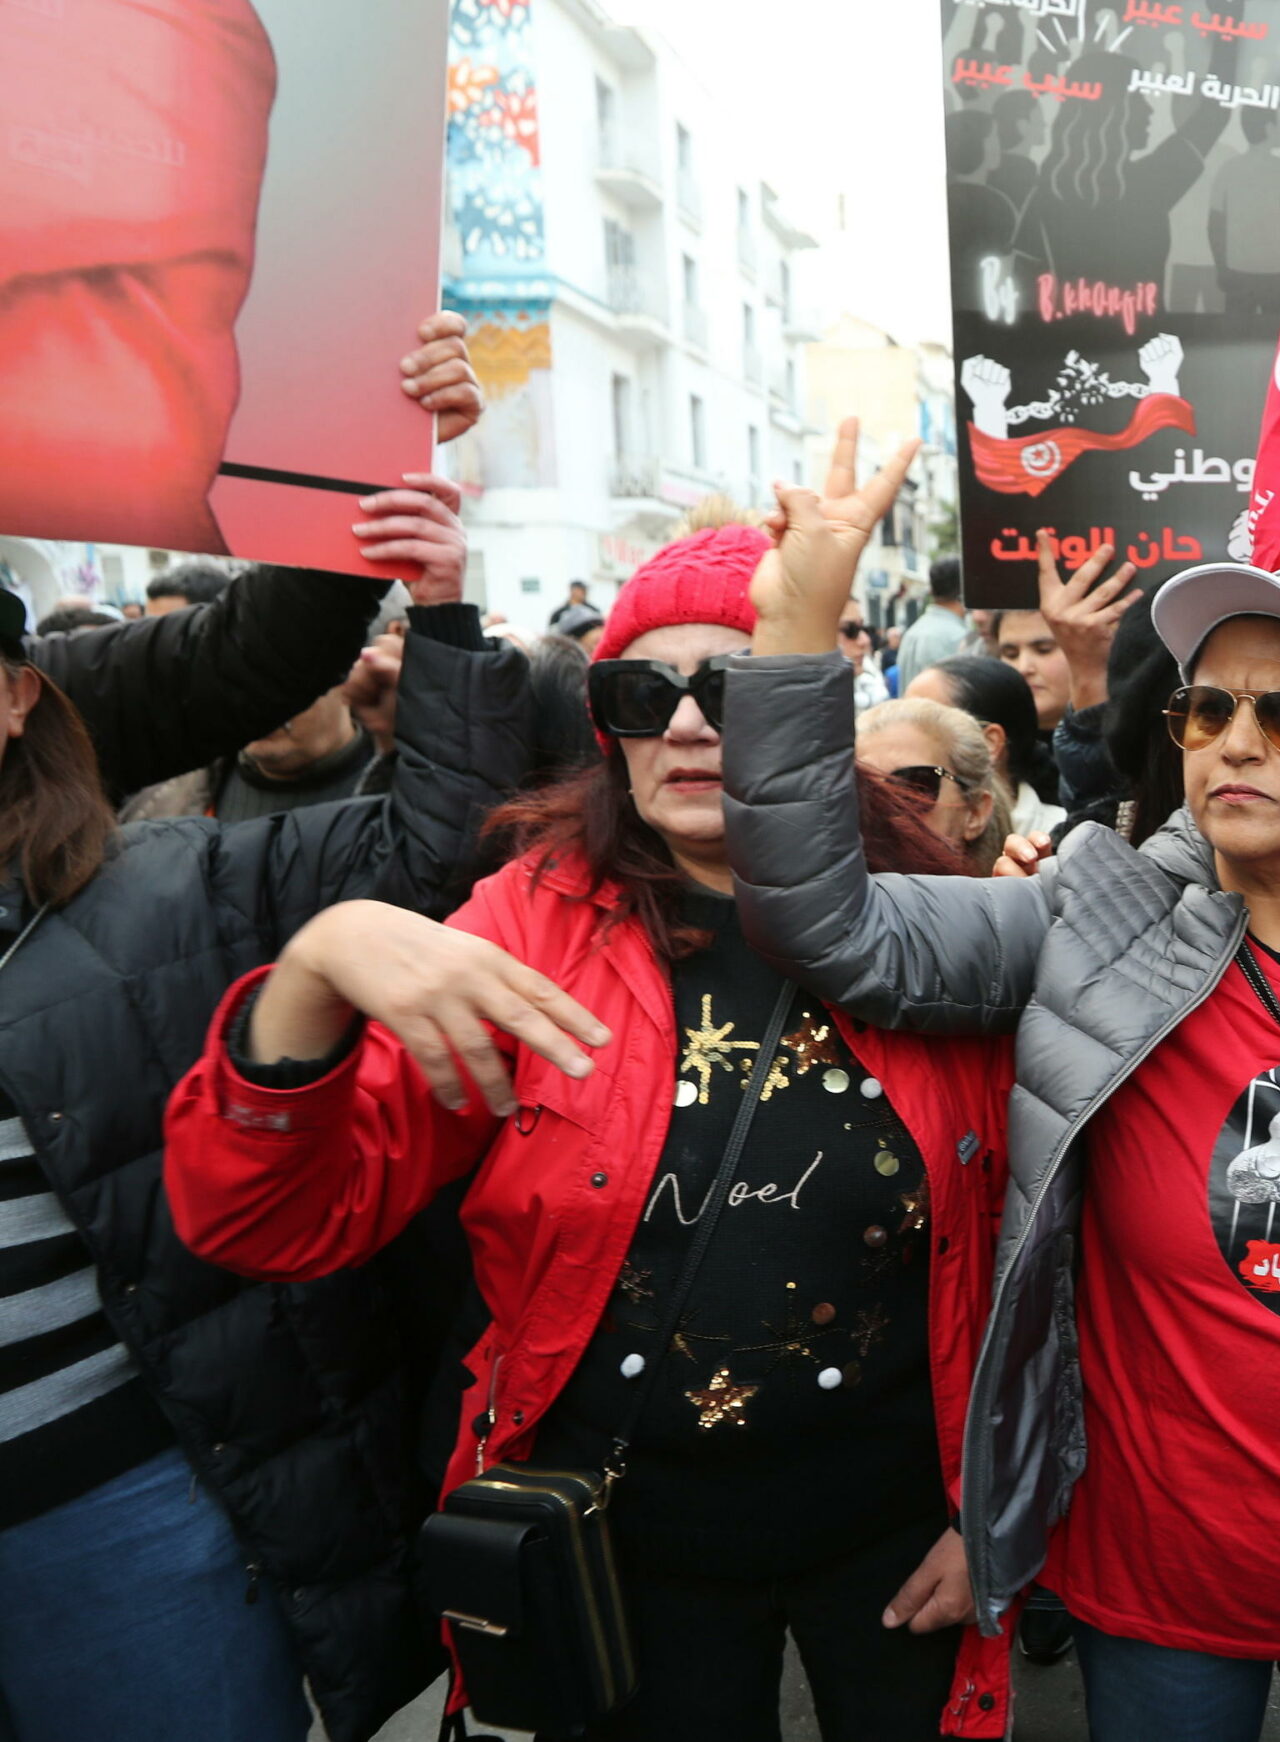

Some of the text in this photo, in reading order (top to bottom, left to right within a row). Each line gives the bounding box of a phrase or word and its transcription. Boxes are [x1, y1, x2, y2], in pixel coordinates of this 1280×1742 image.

[1191, 11, 1268, 41] سيب
[951, 57, 1103, 101] سيب عبير
[1128, 69, 1280, 110] الحرية لعبير
[1129, 448, 1256, 500] وطني
[990, 527, 1203, 569] حان الوقت
[644, 1151, 823, 1225] Noel
